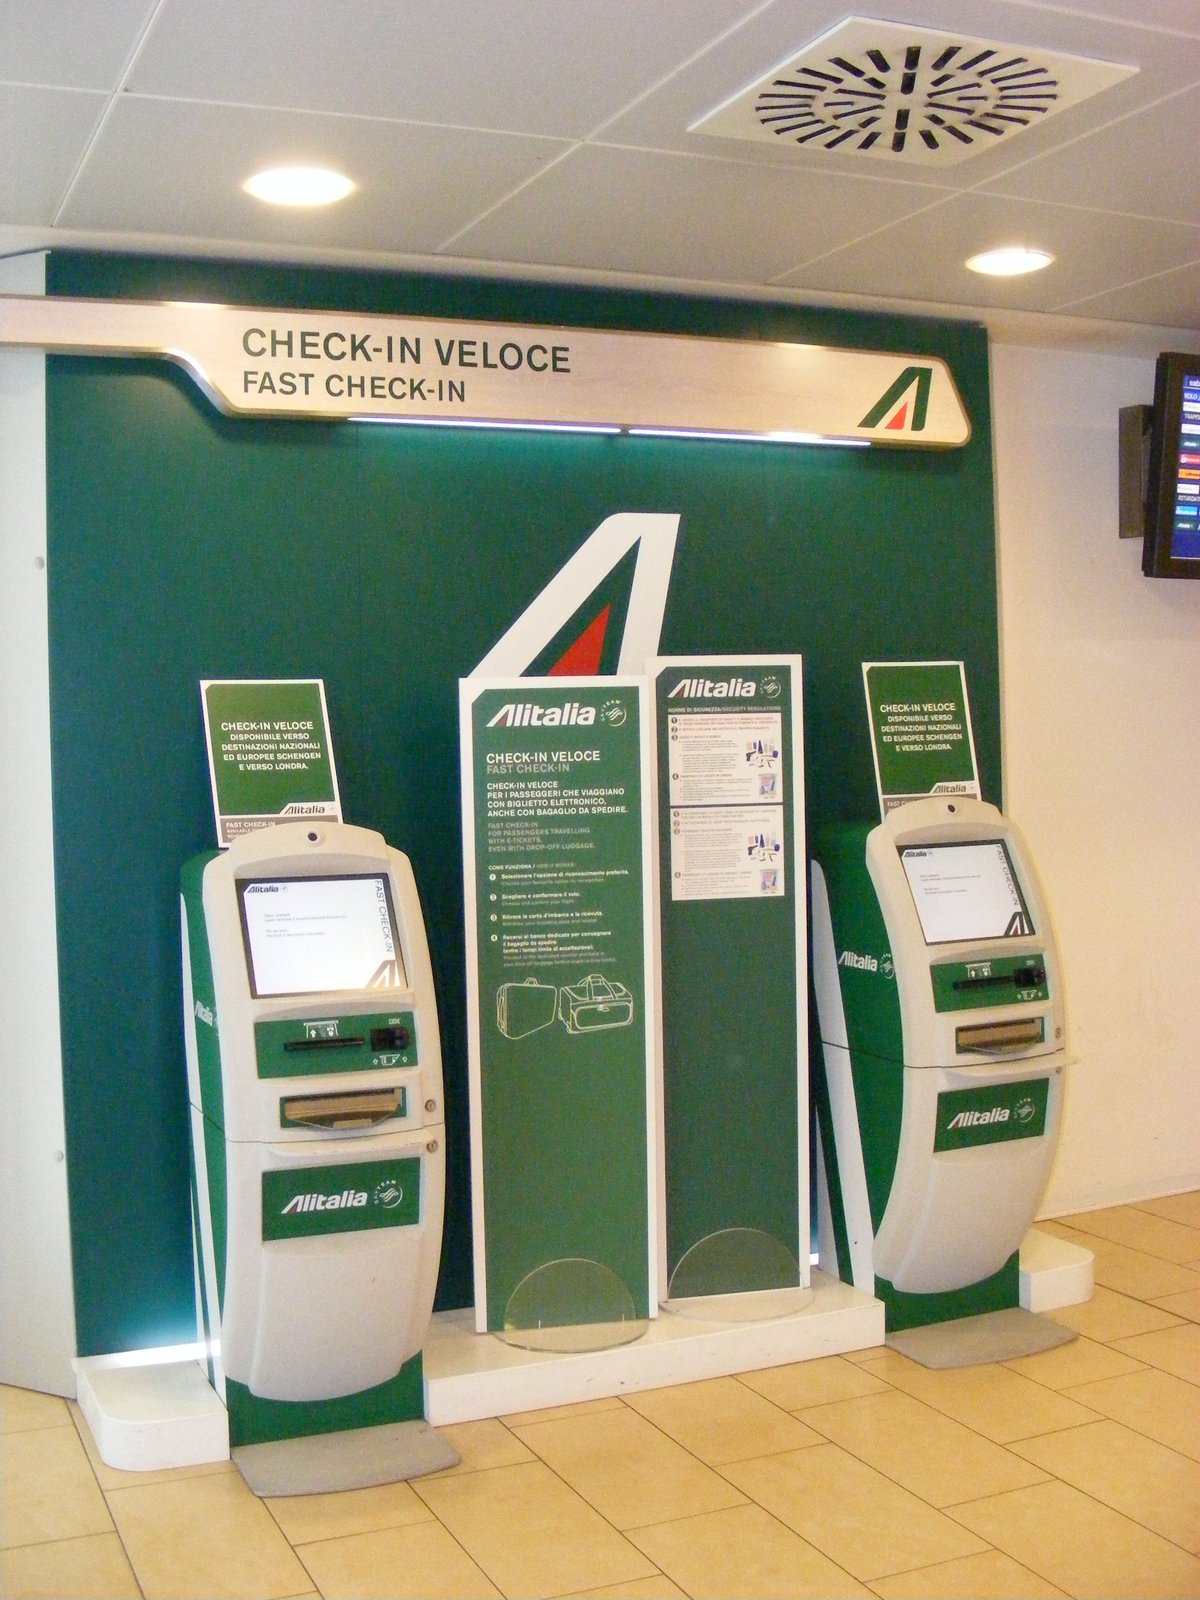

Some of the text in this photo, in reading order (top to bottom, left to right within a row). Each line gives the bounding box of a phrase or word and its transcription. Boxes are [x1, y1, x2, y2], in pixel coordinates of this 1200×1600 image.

[242, 328, 571, 373] CHECK-IN VELOCE
[243, 370, 466, 402] FAST CHECK-IN
[667, 679, 756, 698] Alitalia
[880, 703, 956, 713] CHECK-IN VELOCE
[486, 703, 596, 727] Alitalia
[888, 715, 929, 723] DISPONIBILE
[221, 721, 314, 731] CHECK-IN VELOCE
[881, 725, 927, 733] DESTINAZIONI
[230, 733, 281, 741] DISPONIBILE
[893, 734, 924, 742] EUROPEE
[926, 733, 962, 741] SCHENGEN
[222, 742, 320, 751] DESTINAZIONI NAZIONALI
[902, 744, 923, 752] VERSO
[224, 752, 321, 761] ED EUROPEE SCHENGEN
[486, 750, 600, 764] CHECK-IN VELOCE
[486, 763, 570, 774] FAST CHECK-IN
[487, 781, 558, 790] CHECK-IN VELOCE
[933, 784, 966, 794] Alitalia
[487, 791, 503, 799] PER
[510, 790, 561, 798] PASSEGGERI
[562, 789, 579, 797] CHE
[581, 788, 625, 796] VIAGGIANO
[487, 800, 505, 808] CON
[507, 799, 548, 807] BIGLIETTO
[284, 805, 325, 815] Alitalia
[487, 809, 515, 817] ANCHE
[536, 807, 577, 816] BAGAGLIO
[579, 807, 589, 815] DA
[591, 806, 627, 814] SPEDIRE.
[503, 829, 549, 837] PASSENGERS
[526, 843, 560, 851] DROP-OFF
[247, 885, 279, 894] Alitalia
[374, 880, 393, 953] FAST CHECK-IN
[837, 950, 877, 972] Alitalia
[947, 1107, 1010, 1129] Alitalia
[280, 1189, 368, 1215] Alitalia
